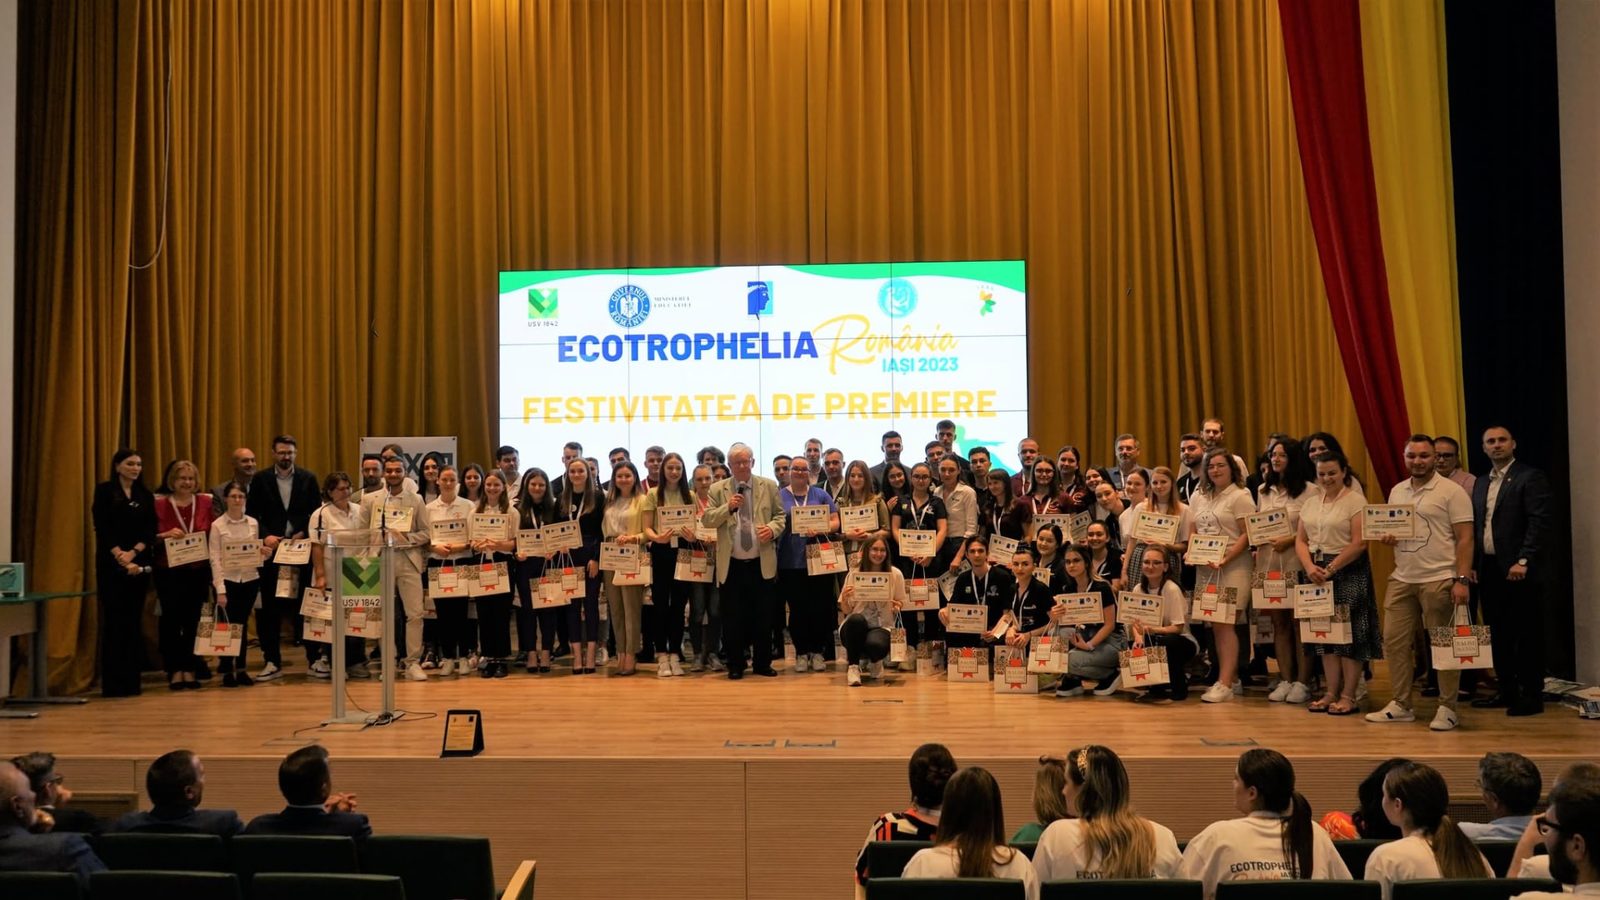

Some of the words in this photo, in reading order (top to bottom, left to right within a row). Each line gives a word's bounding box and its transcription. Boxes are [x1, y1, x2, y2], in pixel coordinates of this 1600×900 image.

[558, 331, 819, 362] ECOTROPHELIA
[812, 313, 960, 375] România
[882, 358, 914, 374] IAȘI
[918, 357, 959, 372] 2023
[523, 394, 762, 424] FESTIVITATEA
[772, 393, 815, 420] DE
[825, 390, 997, 420] PREMIERE
[343, 599, 359, 607] USV
[362, 599, 380, 607] 1842
[1230, 861, 1300, 873] ECOTROPHE
